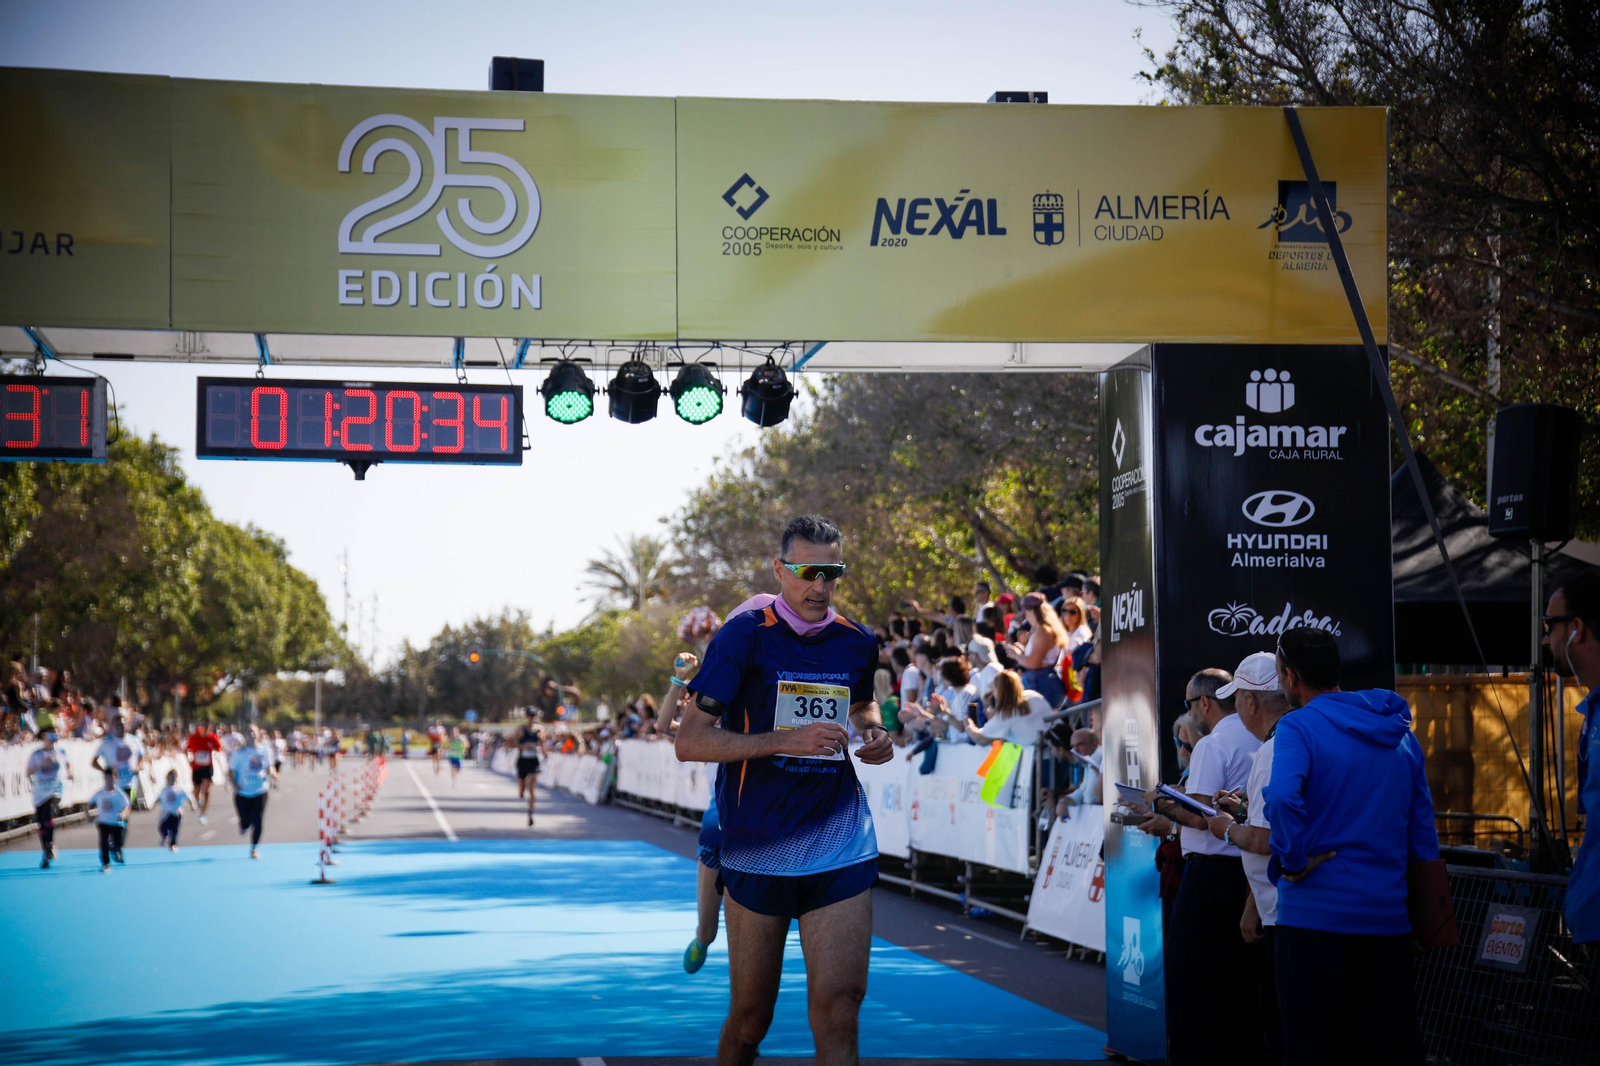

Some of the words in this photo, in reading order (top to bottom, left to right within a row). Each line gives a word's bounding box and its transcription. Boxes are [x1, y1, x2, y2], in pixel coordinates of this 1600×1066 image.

[338, 113, 541, 259] 25
[1094, 190, 1231, 220] ALMERÍA
[870, 189, 1007, 247] NEXAL
[722, 226, 841, 242] COOPERACIÓN
[881, 237, 908, 248] 2020
[1094, 225, 1164, 241] CIUDAD
[0, 231, 74, 256] JAR
[722, 242, 762, 256] 2005
[765, 242, 795, 251] Deporte,
[797, 242, 812, 250] ocio
[813, 243, 818, 251] y
[820, 242, 844, 251] cultura
[1268, 251, 1324, 261] DEPORTES
[1282, 261, 1328, 271] ALMERIA
[338, 264, 542, 309] EDICIÓN
[250, 386, 508, 453] 01:20:34
[1194, 415, 1348, 457] cajamar
[1268, 449, 1300, 460] CAJA
[1303, 450, 1344, 460] RURAL
[1227, 533, 1328, 550] HYUNDAI
[1230, 552, 1326, 568] Almerialva
[1111, 582, 1145, 642] NEXAL
[794, 696, 838, 720] 363
[1485, 939, 1524, 958] EVENTOS
